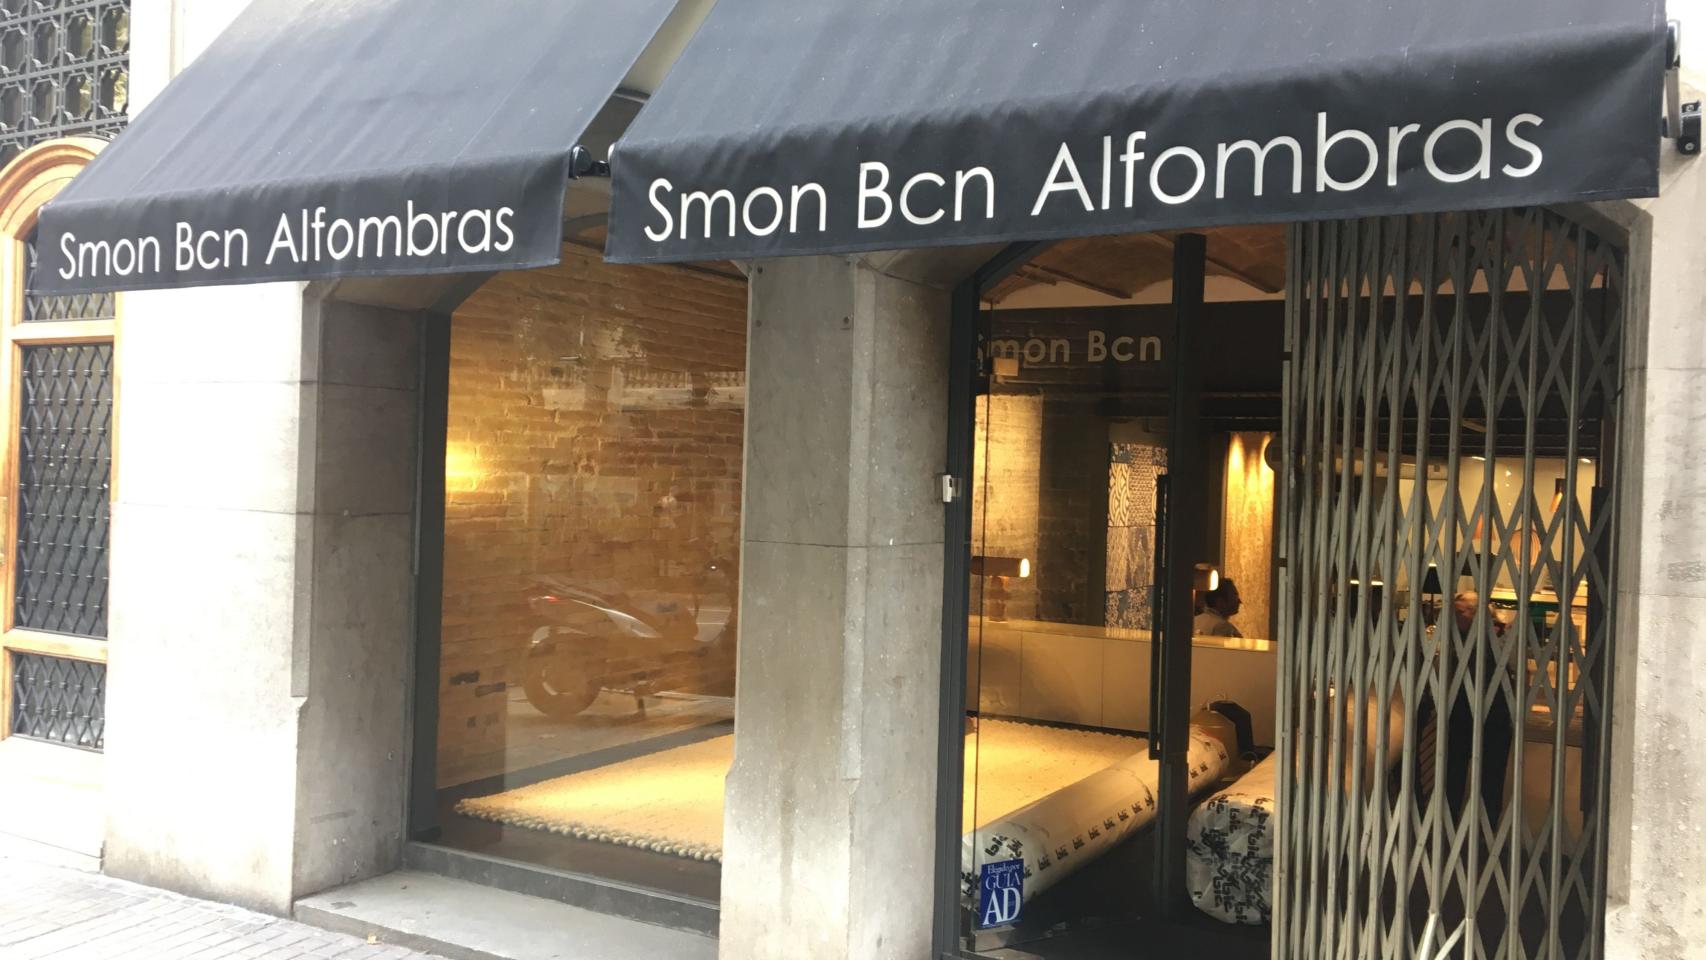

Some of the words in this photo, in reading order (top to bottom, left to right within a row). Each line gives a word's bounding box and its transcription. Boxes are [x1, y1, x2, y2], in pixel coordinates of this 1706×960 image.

[644, 178, 826, 241] Smon
[858, 162, 994, 228] Bcn
[1031, 112, 1543, 215] Alfombras
[59, 232, 160, 280] Smon
[176, 222, 248, 271] Bcn
[265, 200, 514, 264] Alfombras
[1087, 330, 1161, 362] Bcn
[982, 887, 1021, 925] AD
